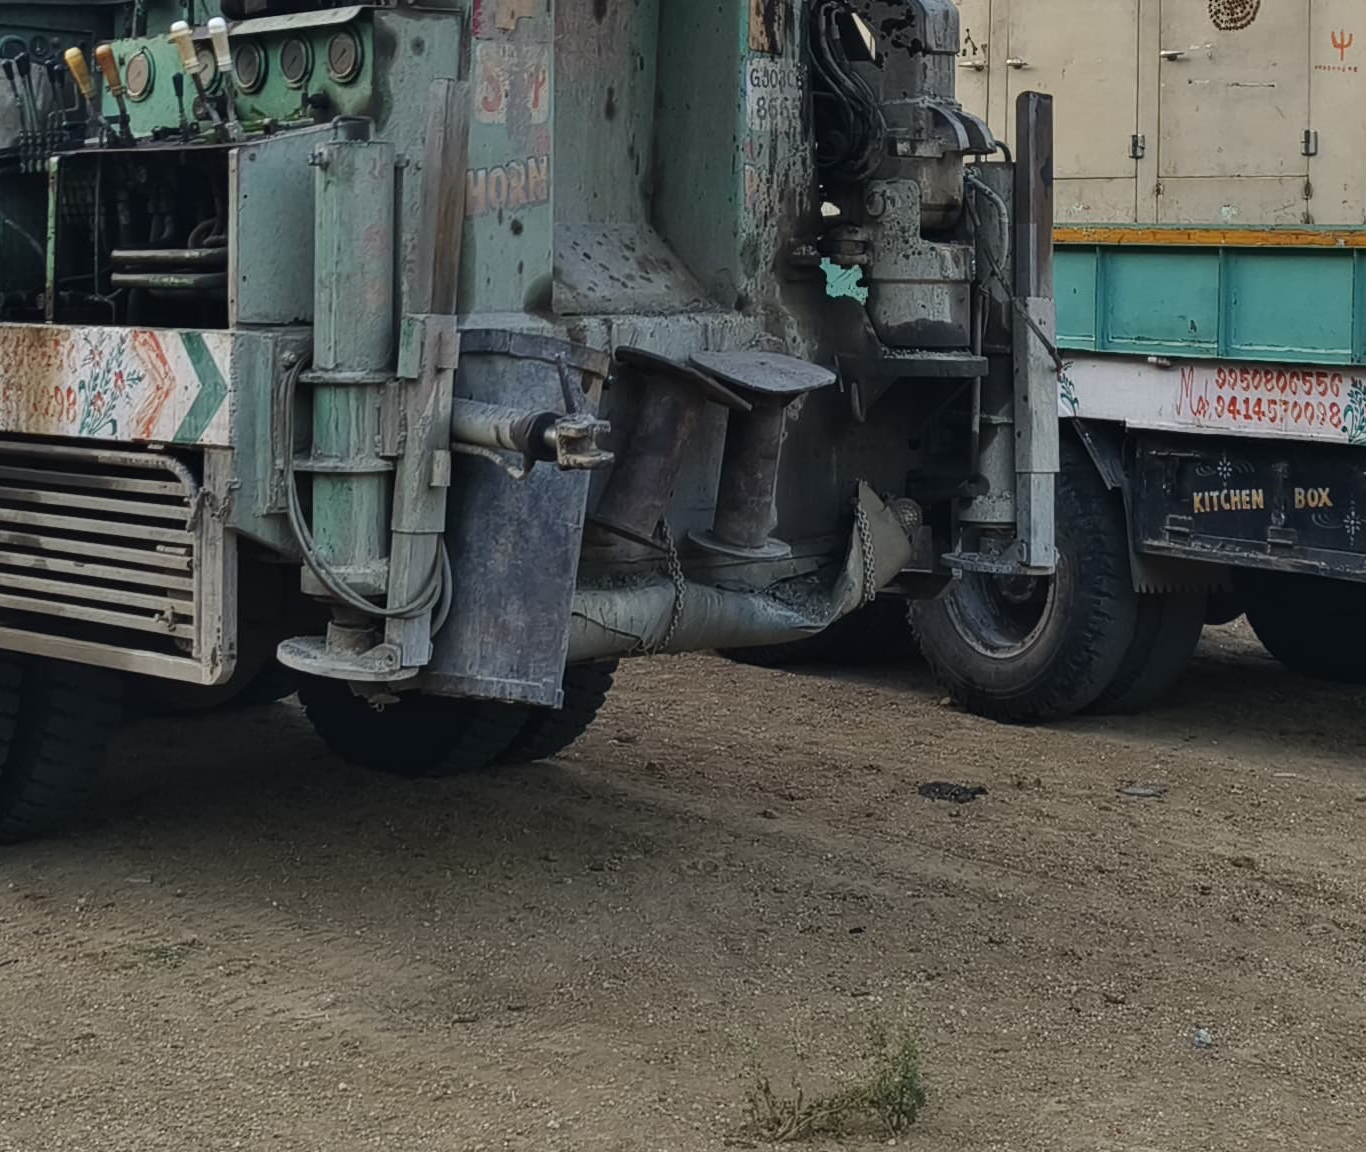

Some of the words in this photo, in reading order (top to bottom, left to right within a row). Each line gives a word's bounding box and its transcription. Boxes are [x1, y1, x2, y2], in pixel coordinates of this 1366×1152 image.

[467, 156, 549, 217] HORN
[1193, 488, 1264, 513] KITCHEN
[1294, 487, 1333, 509] BOX
